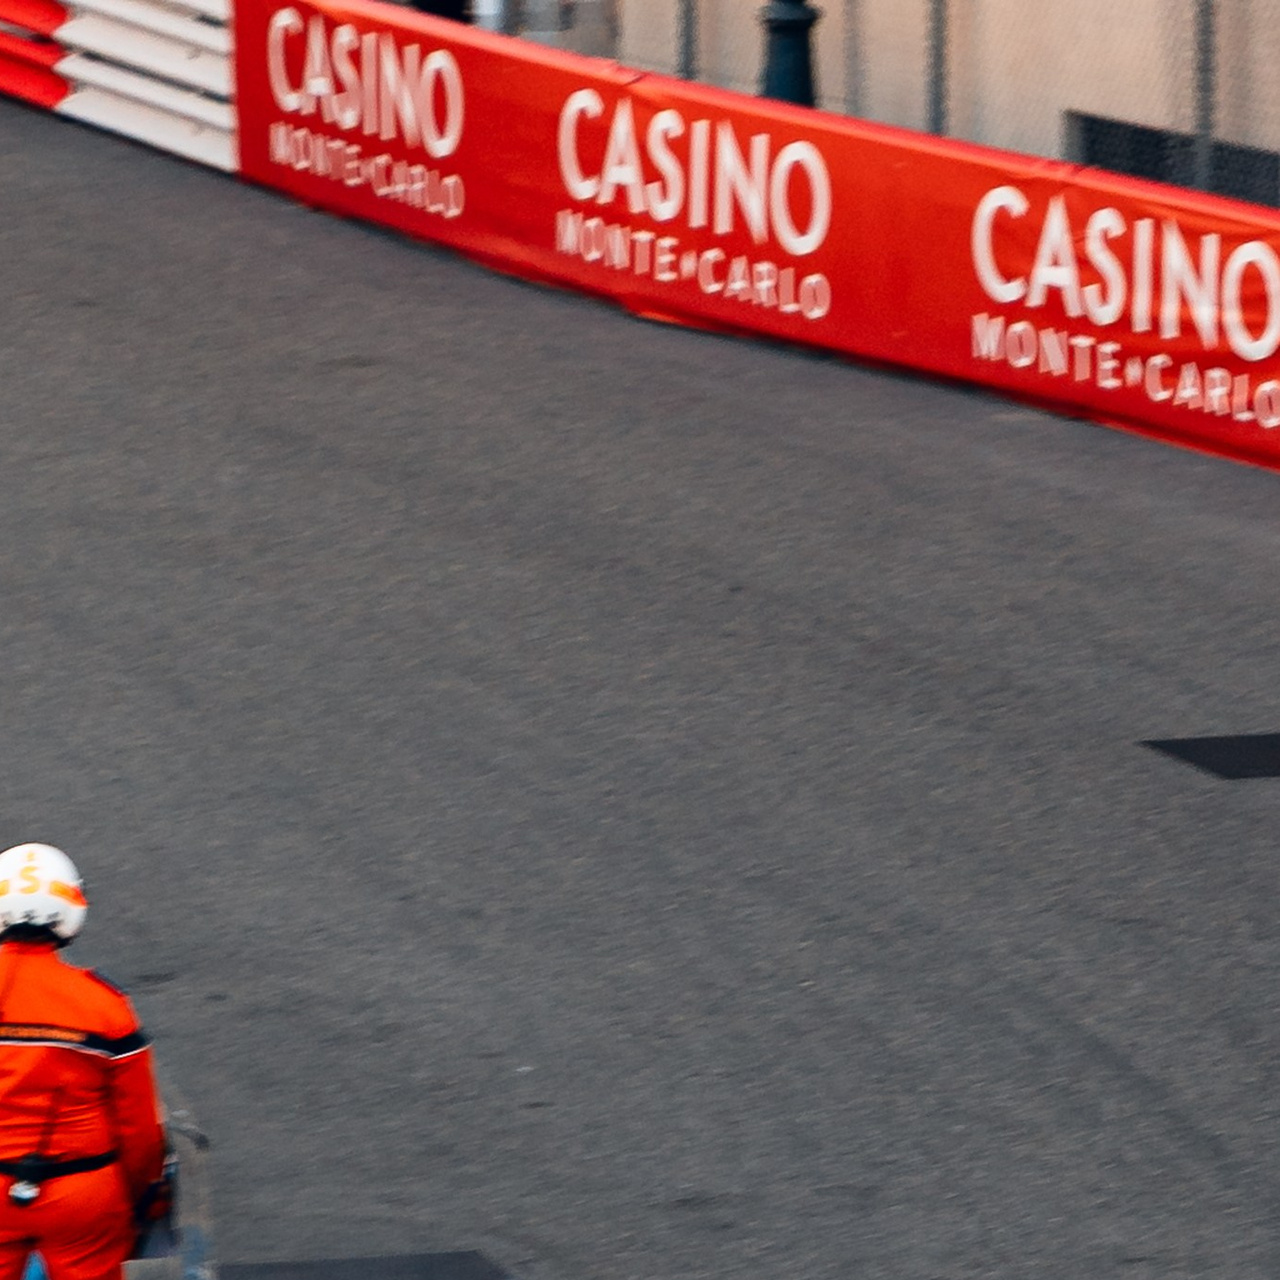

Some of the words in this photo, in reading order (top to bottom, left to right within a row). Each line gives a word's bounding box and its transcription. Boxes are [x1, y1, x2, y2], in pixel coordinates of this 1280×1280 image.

[267, 8, 465, 158] CASINO
[557, 88, 831, 256] CASINO
[971, 185, 1280, 361] CASINO
